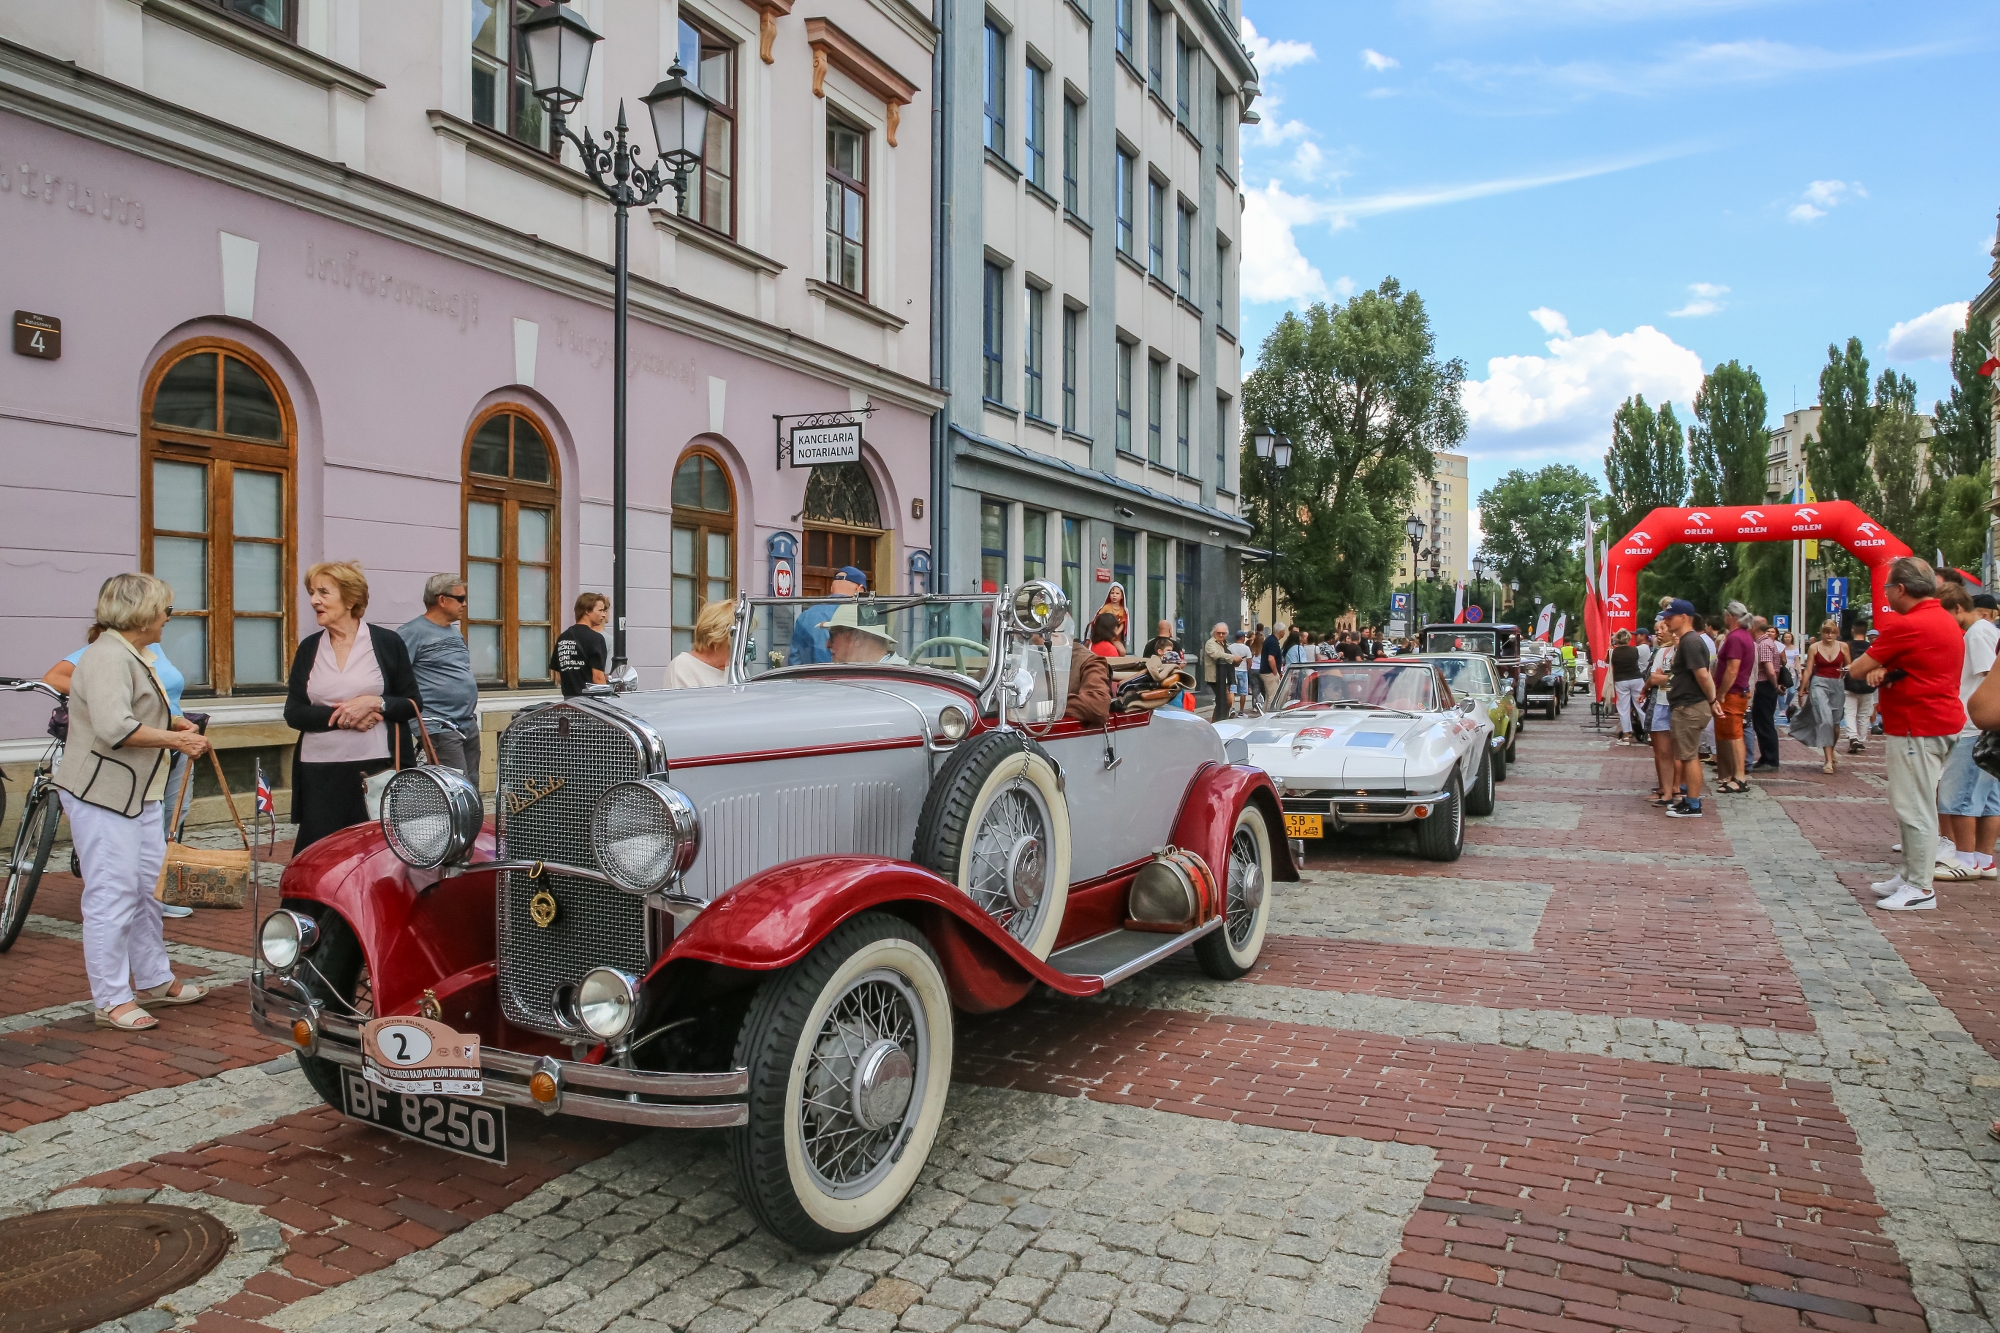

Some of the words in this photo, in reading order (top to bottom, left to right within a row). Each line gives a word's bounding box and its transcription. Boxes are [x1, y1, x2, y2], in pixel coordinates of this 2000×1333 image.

[31, 331, 45, 352] 4
[798, 432, 854, 445] KANCELARIA
[798, 446, 854, 459] NOTARIALNA
[1737, 526, 1767, 534] ORLEN
[1791, 523, 1822, 532] ORLEN
[1854, 539, 1885, 547] ORLEN
[1291, 816, 1306, 825] SB
[392, 1032, 411, 1060] 2
[349, 1074, 390, 1120] BF
[401, 1093, 496, 1154] 8250
